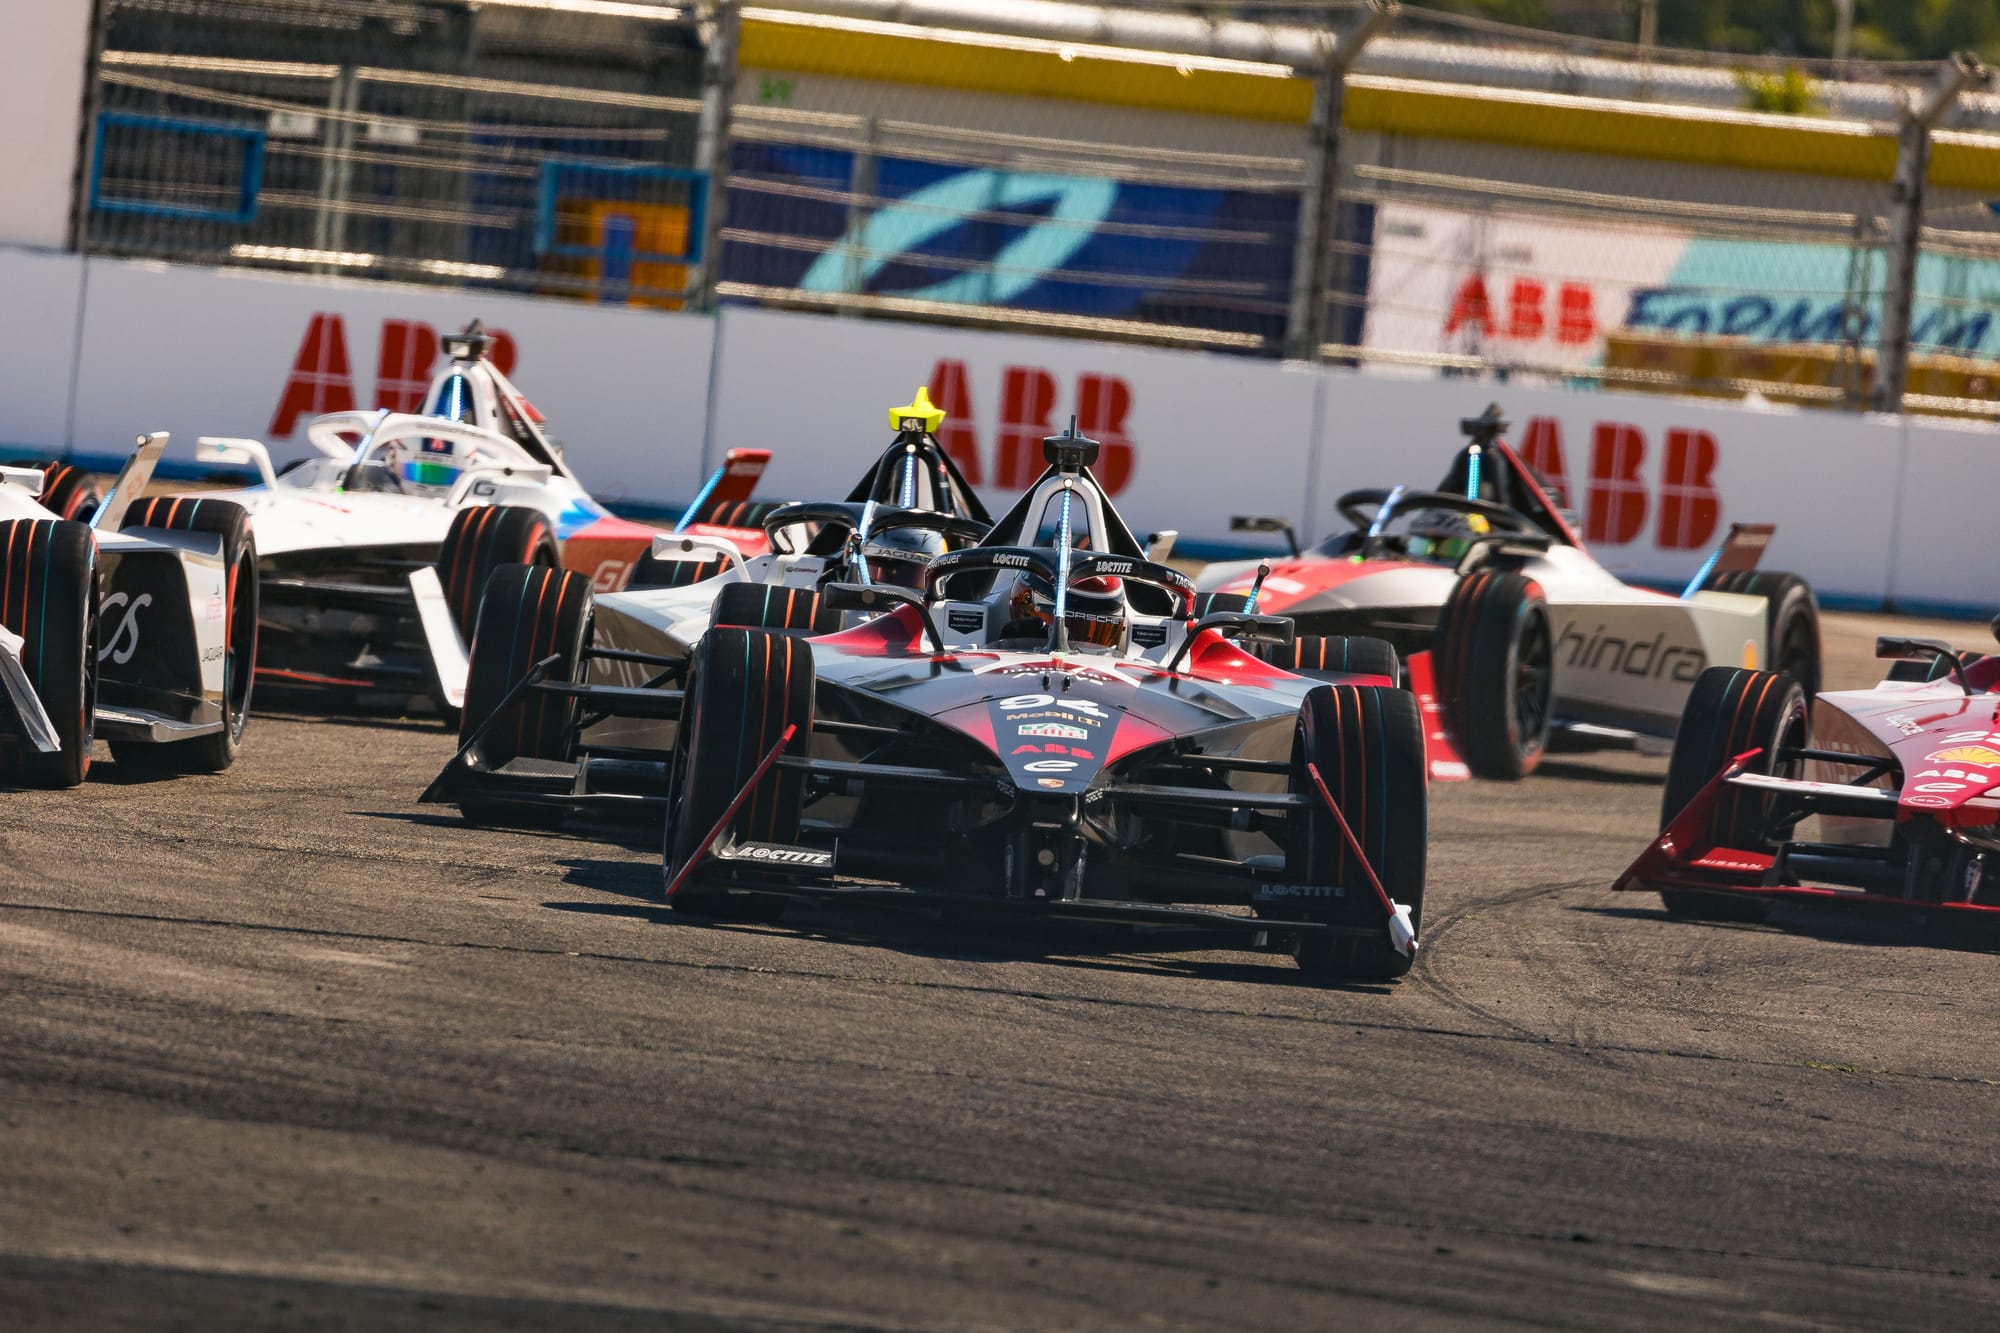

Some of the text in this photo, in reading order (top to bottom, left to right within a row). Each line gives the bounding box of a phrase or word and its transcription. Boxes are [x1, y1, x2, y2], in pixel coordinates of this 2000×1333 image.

[1443, 272, 1595, 345] ABB
[992, 553, 1030, 567] LOCTITE
[1095, 561, 1132, 574] LOCTITE
[1063, 610, 1121, 625] ORSCHE
[999, 694, 1109, 719] 94
[1006, 710, 1074, 721] Mobil
[1010, 743, 1095, 760] ABB
[1912, 769, 1989, 784] ABB
[737, 846, 833, 864] LOCTITE
[1261, 884, 1345, 897] LOCTITE
